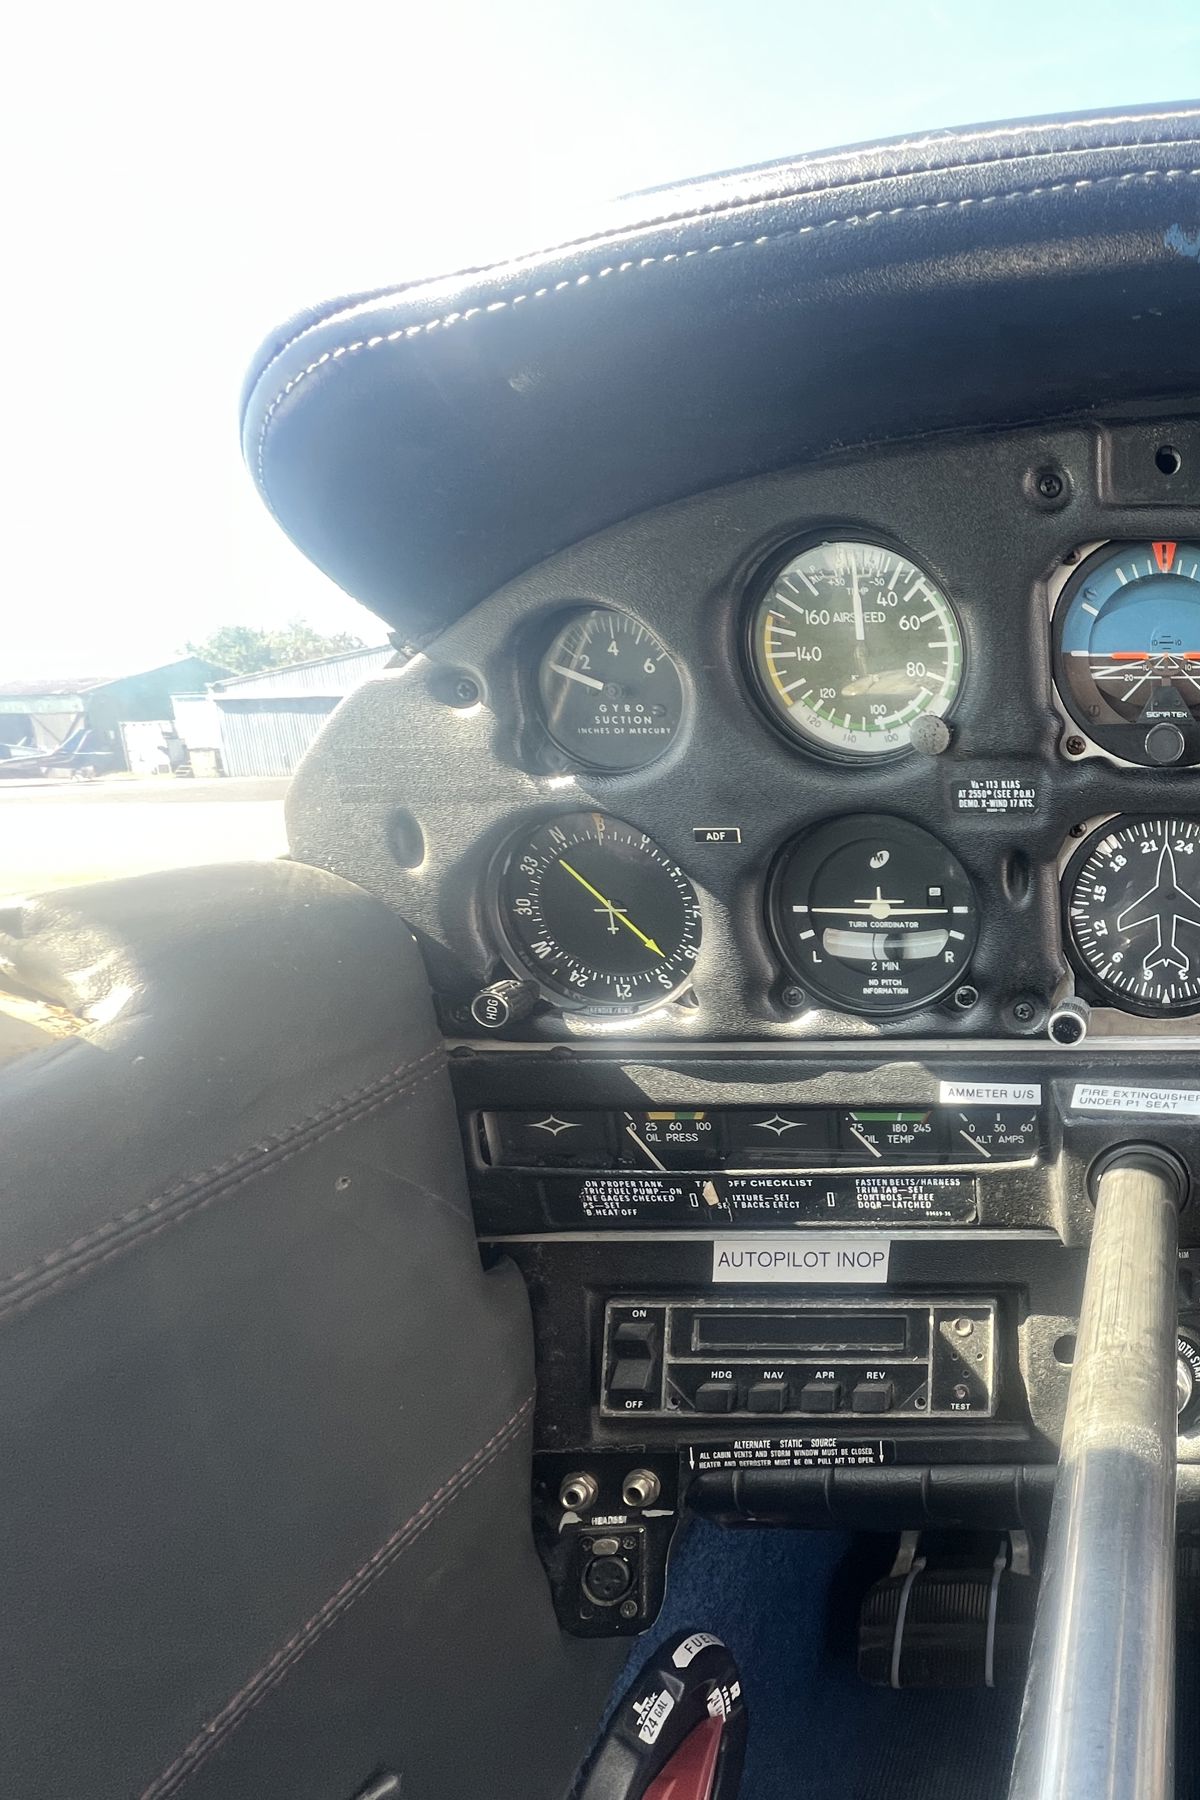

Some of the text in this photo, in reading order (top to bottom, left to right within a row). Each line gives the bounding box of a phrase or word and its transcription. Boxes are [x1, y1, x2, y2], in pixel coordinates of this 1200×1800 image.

[877, 591, 898, 606] 40
[805, 610, 830, 625] 160
[899, 616, 920, 630] 60
[796, 646, 822, 661] 140
[906, 662, 926, 676] 80
[1124, 673, 1134, 681] 20
[820, 688, 836, 698] 120
[600, 704, 645, 713] GYRO
[870, 705, 887, 714] 100
[595, 716, 652, 724] SUCTION
[706, 832, 726, 844] ADF
[1140, 841, 1159, 854] 21
[1174, 840, 1194, 854] 24
[520, 855, 538, 875] 33
[1109, 854, 1127, 872] 18
[1093, 884, 1107, 904] 15
[870, 921, 919, 929] COORDINATOR
[863, 987, 908, 995] INFORMATION
[486, 999, 499, 1021] HDG
[948, 1087, 1034, 1100] AMMETER U/S
[1081, 1088, 1109, 1097] FIRE
[1080, 1097, 1177, 1109] UNDER P1 SEAT
[669, 1122, 682, 1131] 60
[696, 1122, 711, 1131] 100
[893, 1122, 908, 1132] 180
[913, 1122, 931, 1132] 245
[1021, 1122, 1033, 1132] 60
[646, 1133, 699, 1142] OIL PRESS
[975, 1134, 1024, 1144] ALT AMPS
[718, 1252, 885, 1267] AUTOPILOT INOP
[711, 1371, 732, 1379] HDG
[763, 1371, 784, 1379] NAV
[815, 1371, 836, 1379] APR
[866, 1371, 886, 1379] REV
[734, 1438, 837, 1449] ALTERNATE STATIC SOURCE
[592, 1515, 627, 1525] HEADSET
[684, 1635, 715, 1654] FUEL
[643, 1700, 669, 1737] 24 GAL
